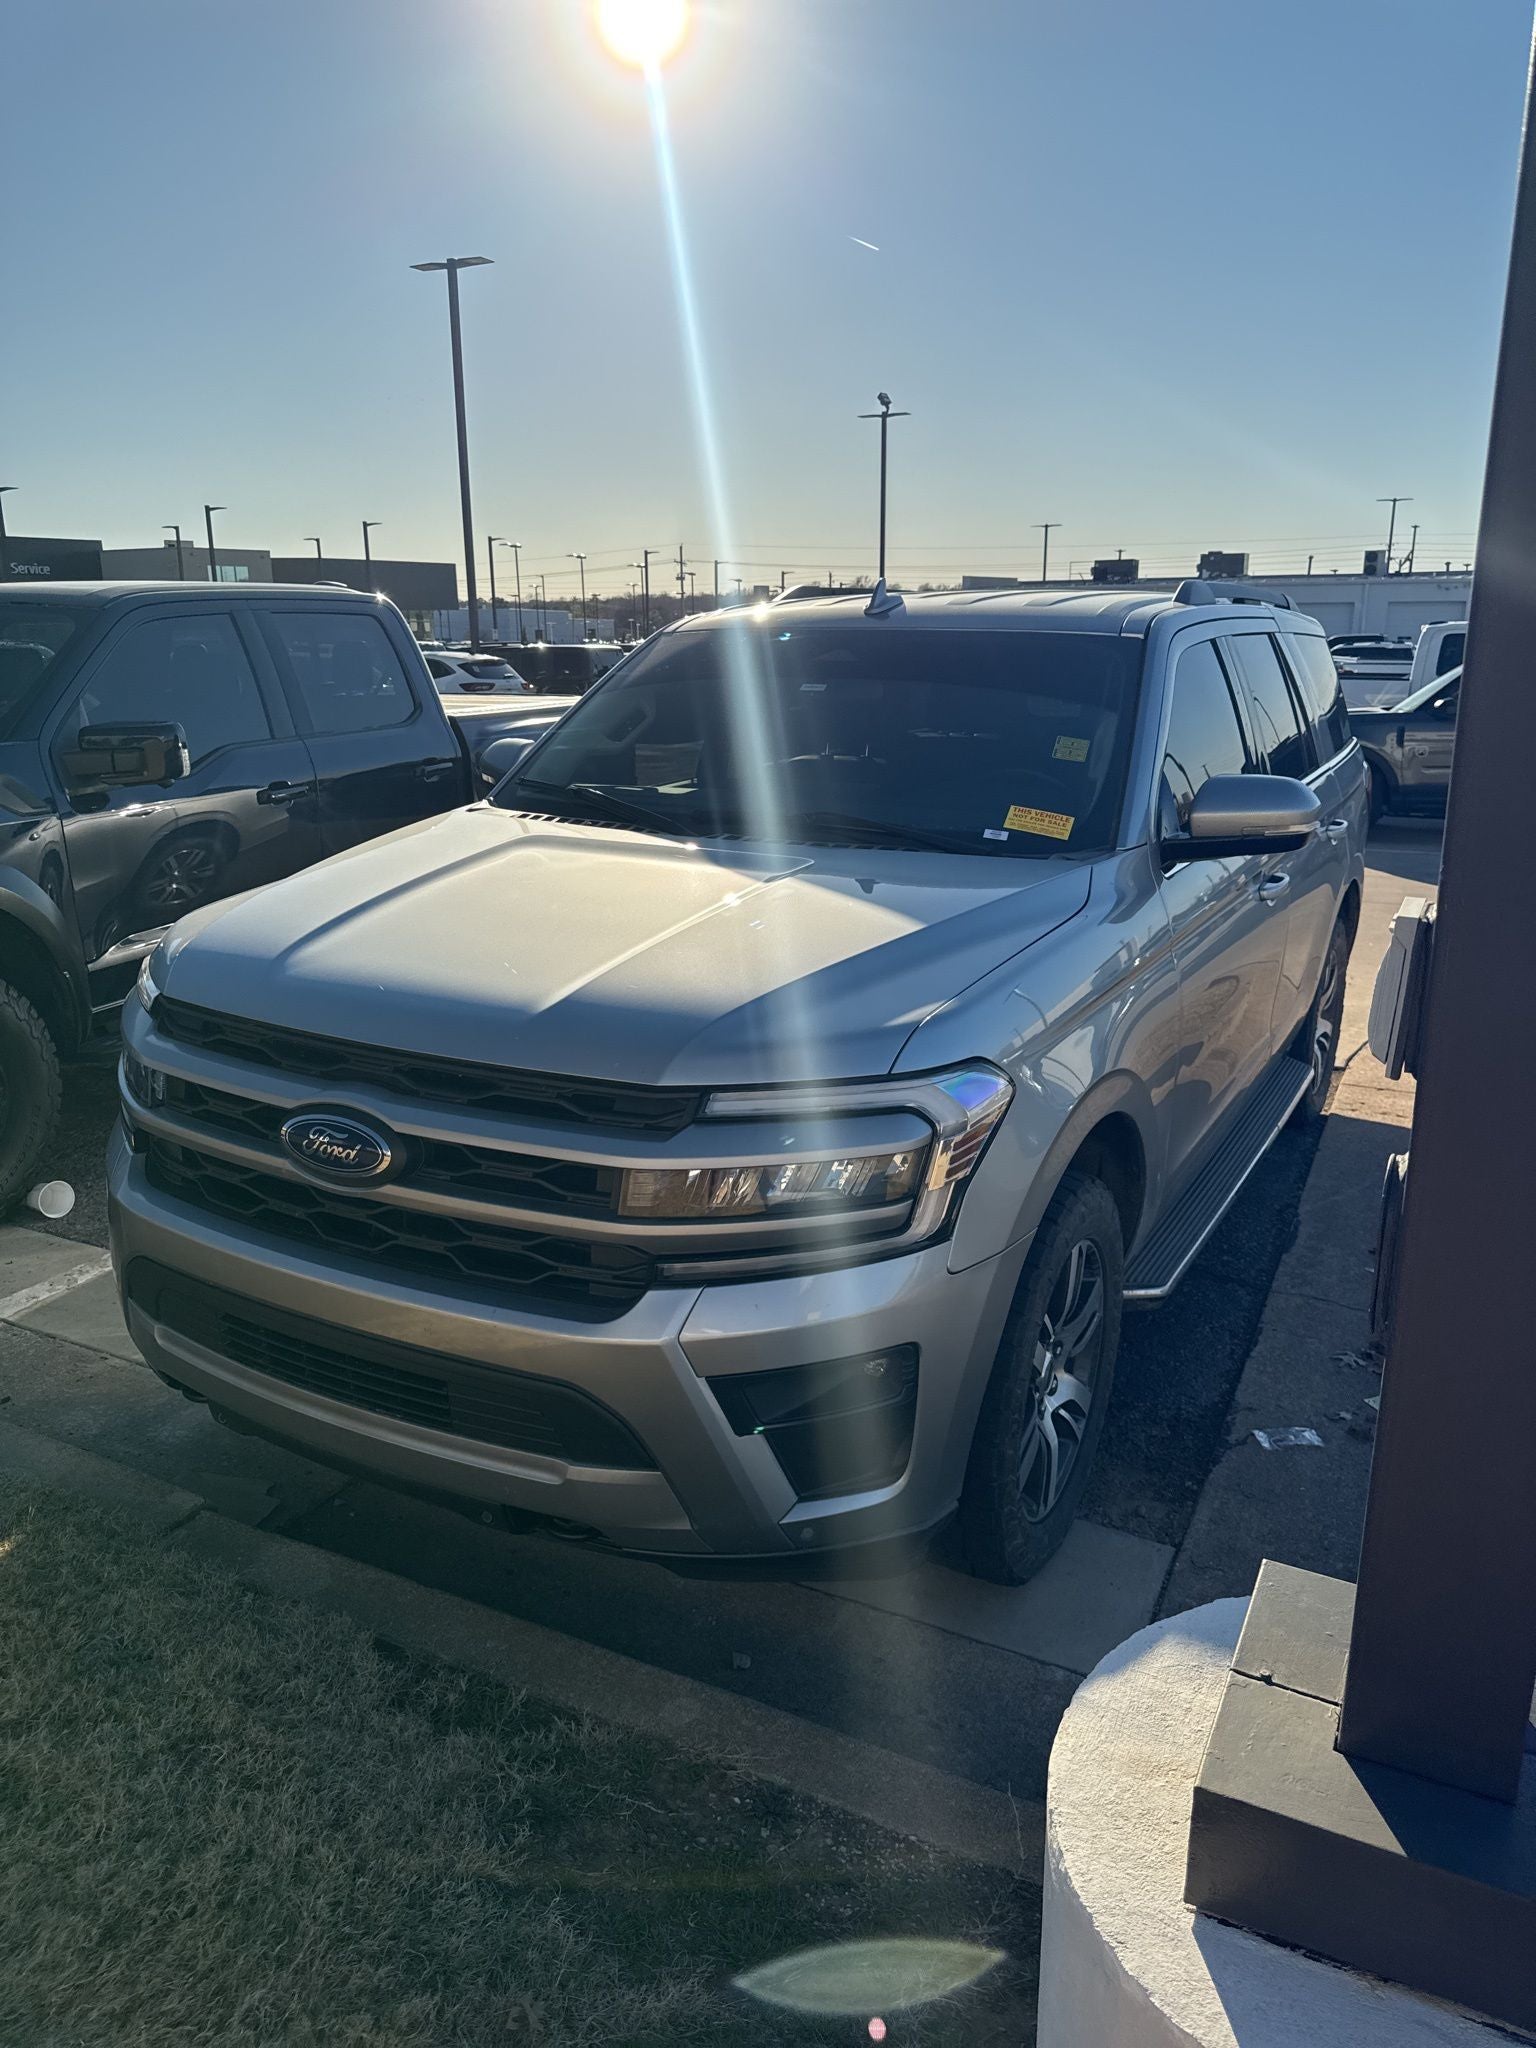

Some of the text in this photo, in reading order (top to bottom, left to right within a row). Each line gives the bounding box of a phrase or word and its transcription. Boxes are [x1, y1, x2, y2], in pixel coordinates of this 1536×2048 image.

[10, 562, 50, 575] Service
[1013, 807, 1032, 816] THIS
[1035, 811, 1072, 824] VEHICLE
[1047, 820, 1068, 828] SALE
[302, 1126, 362, 1165] Ford
